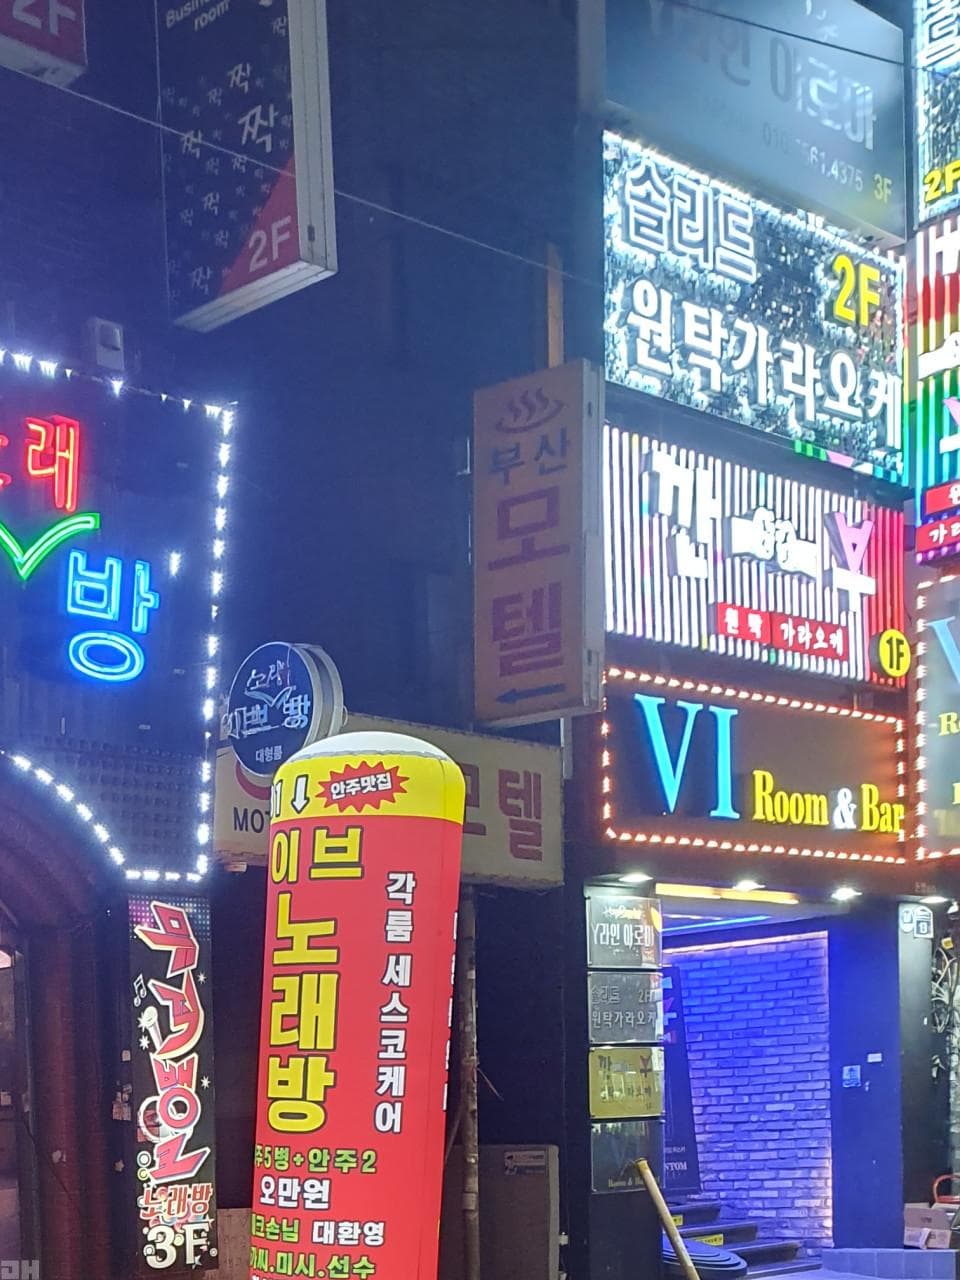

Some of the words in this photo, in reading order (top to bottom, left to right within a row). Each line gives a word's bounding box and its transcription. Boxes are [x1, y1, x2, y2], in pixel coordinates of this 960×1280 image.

[227, 63, 252, 94] 짝
[237, 104, 279, 153] 짝
[872, 173, 893, 204] 3F
[248, 216, 291, 273] 2F
[625, 158, 757, 284] 솔리드
[832, 254, 881, 327] 2F
[627, 280, 903, 450] 원탁가라오케
[490, 425, 570, 486] 부산
[488, 485, 570, 677] 모텔
[66, 549, 160, 682] 방
[780, 617, 845, 656] 가라오케
[886, 636, 905, 671] 1F
[330, 771, 393, 800] 안주맛집
[634, 693, 741, 820] VI
[752, 769, 829, 826] Room
[833, 787, 857, 830] &
[860, 783, 905, 833] Bar
[270, 778, 283, 819] 1
[270, 826, 363, 883] 이브
[266, 892, 339, 1133] 노래방
[140, 1182, 213, 1220] 노래방
[259, 1175, 331, 1210] 오만원
[146, 1222, 210, 1269] 3F
[312, 1219, 385, 1246] 대환영
